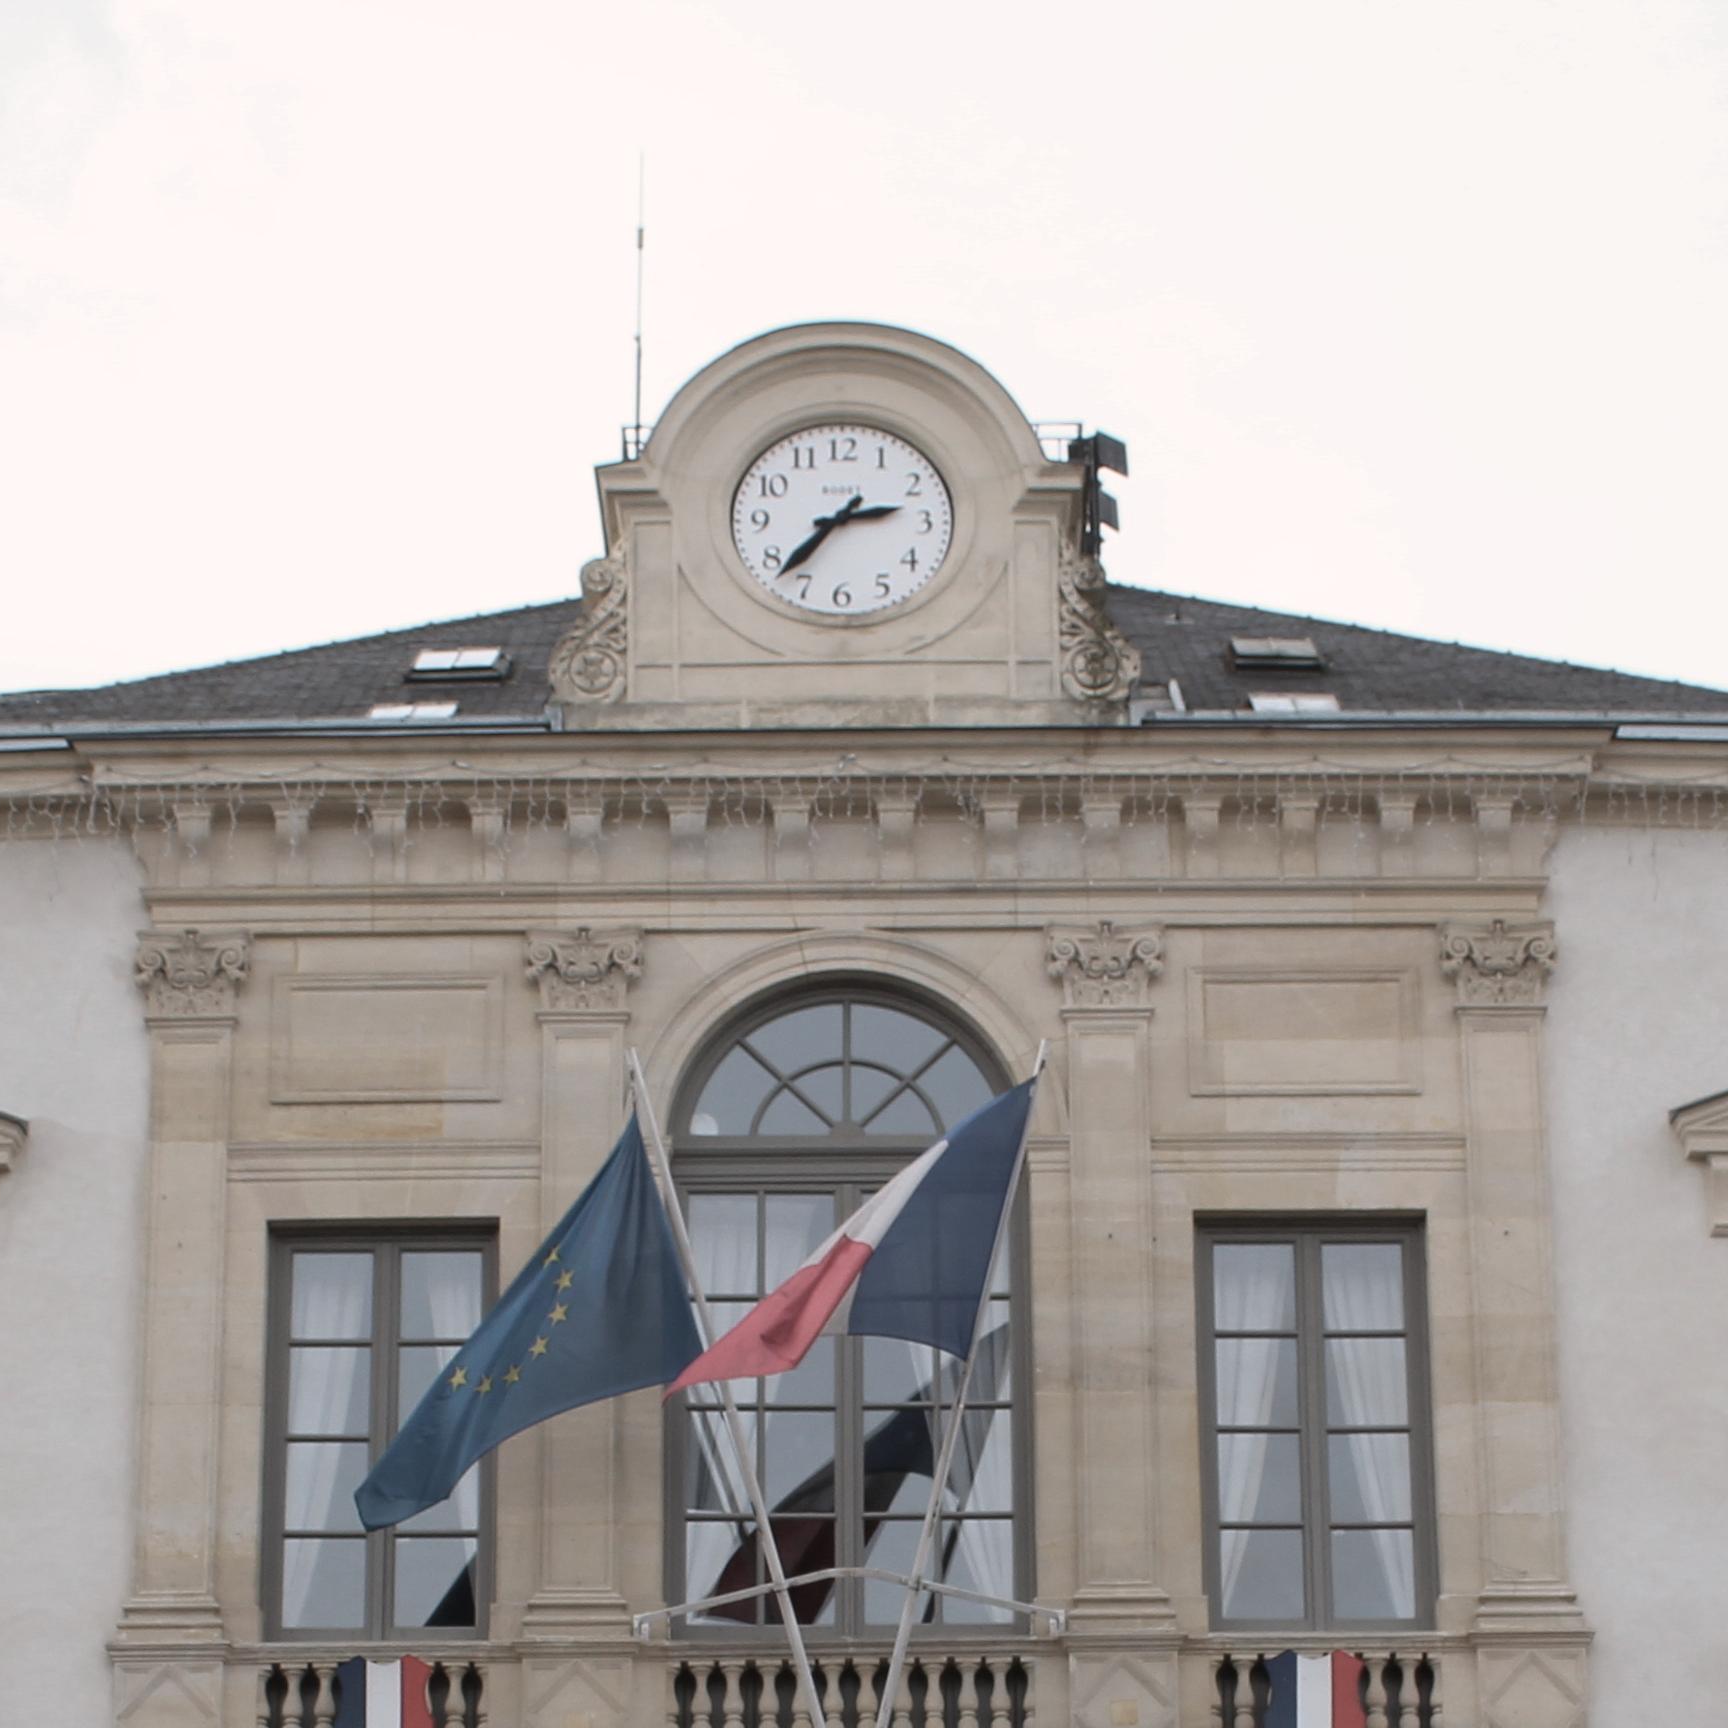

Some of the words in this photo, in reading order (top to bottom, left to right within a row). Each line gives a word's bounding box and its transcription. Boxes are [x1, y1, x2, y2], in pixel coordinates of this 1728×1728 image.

[792, 447, 816, 470] 11
[828, 438, 858, 462] 12
[876, 446, 887, 469] 1
[759, 474, 788, 497] 10
[905, 474, 922, 497] 2
[751, 510, 770, 533] 9
[918, 510, 933, 534] 3
[762, 545, 781, 570] 8
[900, 548, 919, 572] 4
[795, 575, 813, 599] 7
[832, 583, 852, 607] 6
[875, 574, 890, 599] 5
